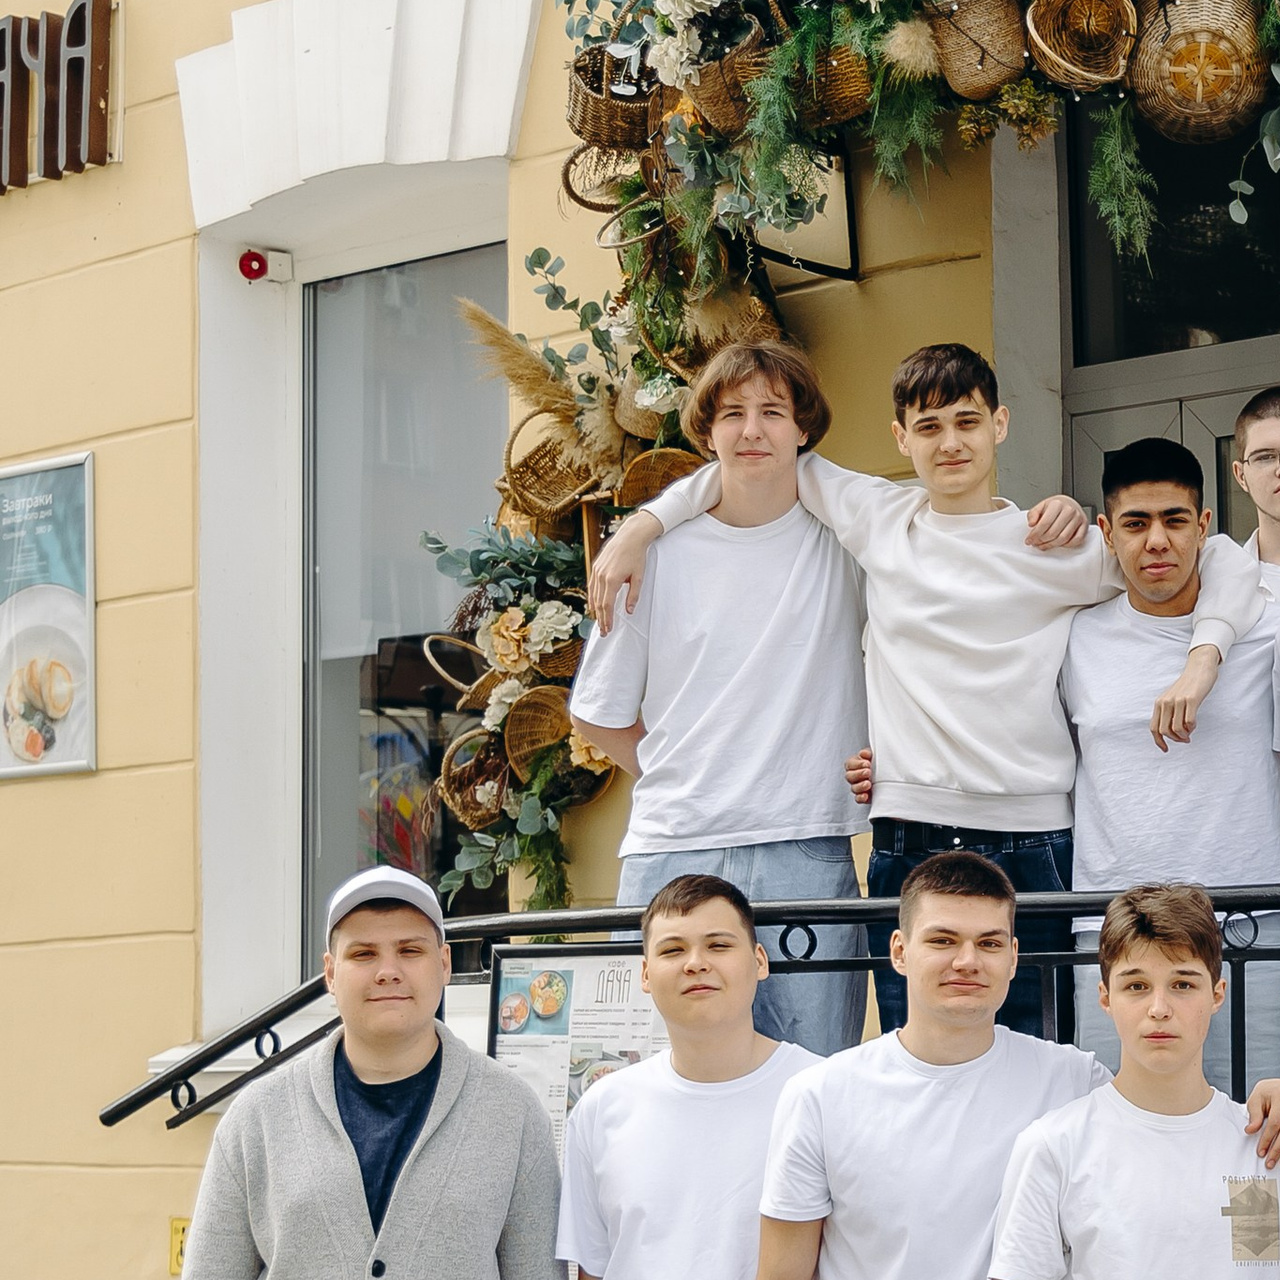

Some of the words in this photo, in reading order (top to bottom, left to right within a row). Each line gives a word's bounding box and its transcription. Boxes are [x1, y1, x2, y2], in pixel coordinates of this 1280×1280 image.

[2, 493, 53, 513] Завтраки
[594, 969, 632, 1004] ДАЧА
[1222, 1174, 1267, 1185] POSITIVITY
